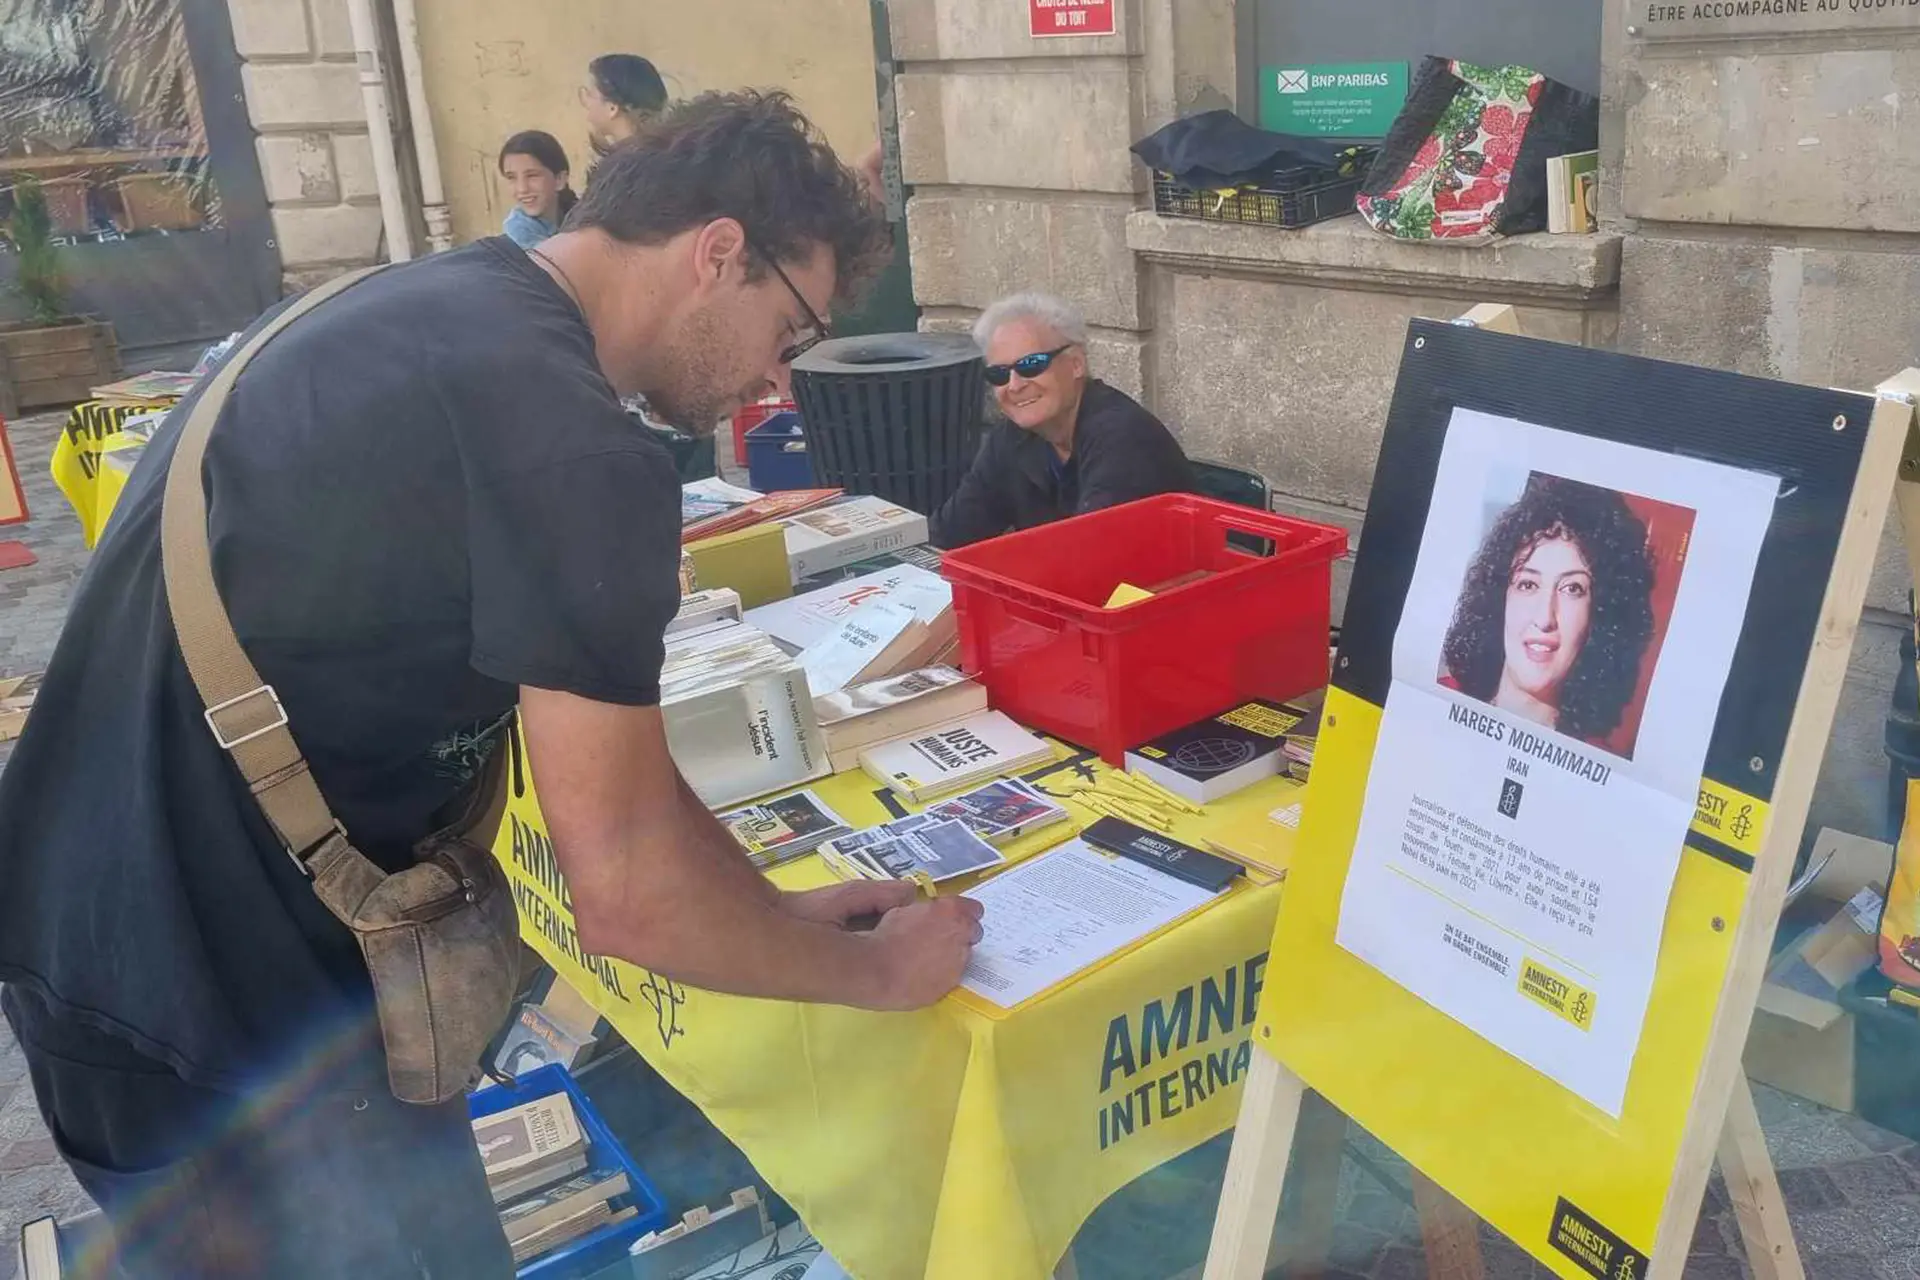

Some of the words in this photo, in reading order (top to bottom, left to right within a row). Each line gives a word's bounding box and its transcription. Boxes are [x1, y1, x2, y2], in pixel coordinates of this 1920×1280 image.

[1055, 11, 1067, 27] DU
[1068, 10, 1086, 26] TOIT
[1647, 3, 1685, 22] ÊTRE
[1816, 0, 1840, 11] AU
[1311, 74, 1335, 88] BNP
[1337, 73, 1389, 87] PARIBAS
[757, 709, 780, 761] l'incident
[917, 736, 968, 768] HUMAINS
[937, 727, 998, 762] JUSTE
[1448, 702, 1506, 741] NARGES
[1508, 727, 1612, 786] MOHAMMADI
[1505, 755, 1530, 778] IRAN
[1583, 892, 1599, 908] 154
[1522, 979, 1566, 1013] INTERNATIONAL
[1524, 965, 1570, 1000] AMNESTY
[1557, 1229, 1608, 1276] INTERNATIONAL
[1560, 1213, 1614, 1261] AMNESTY
